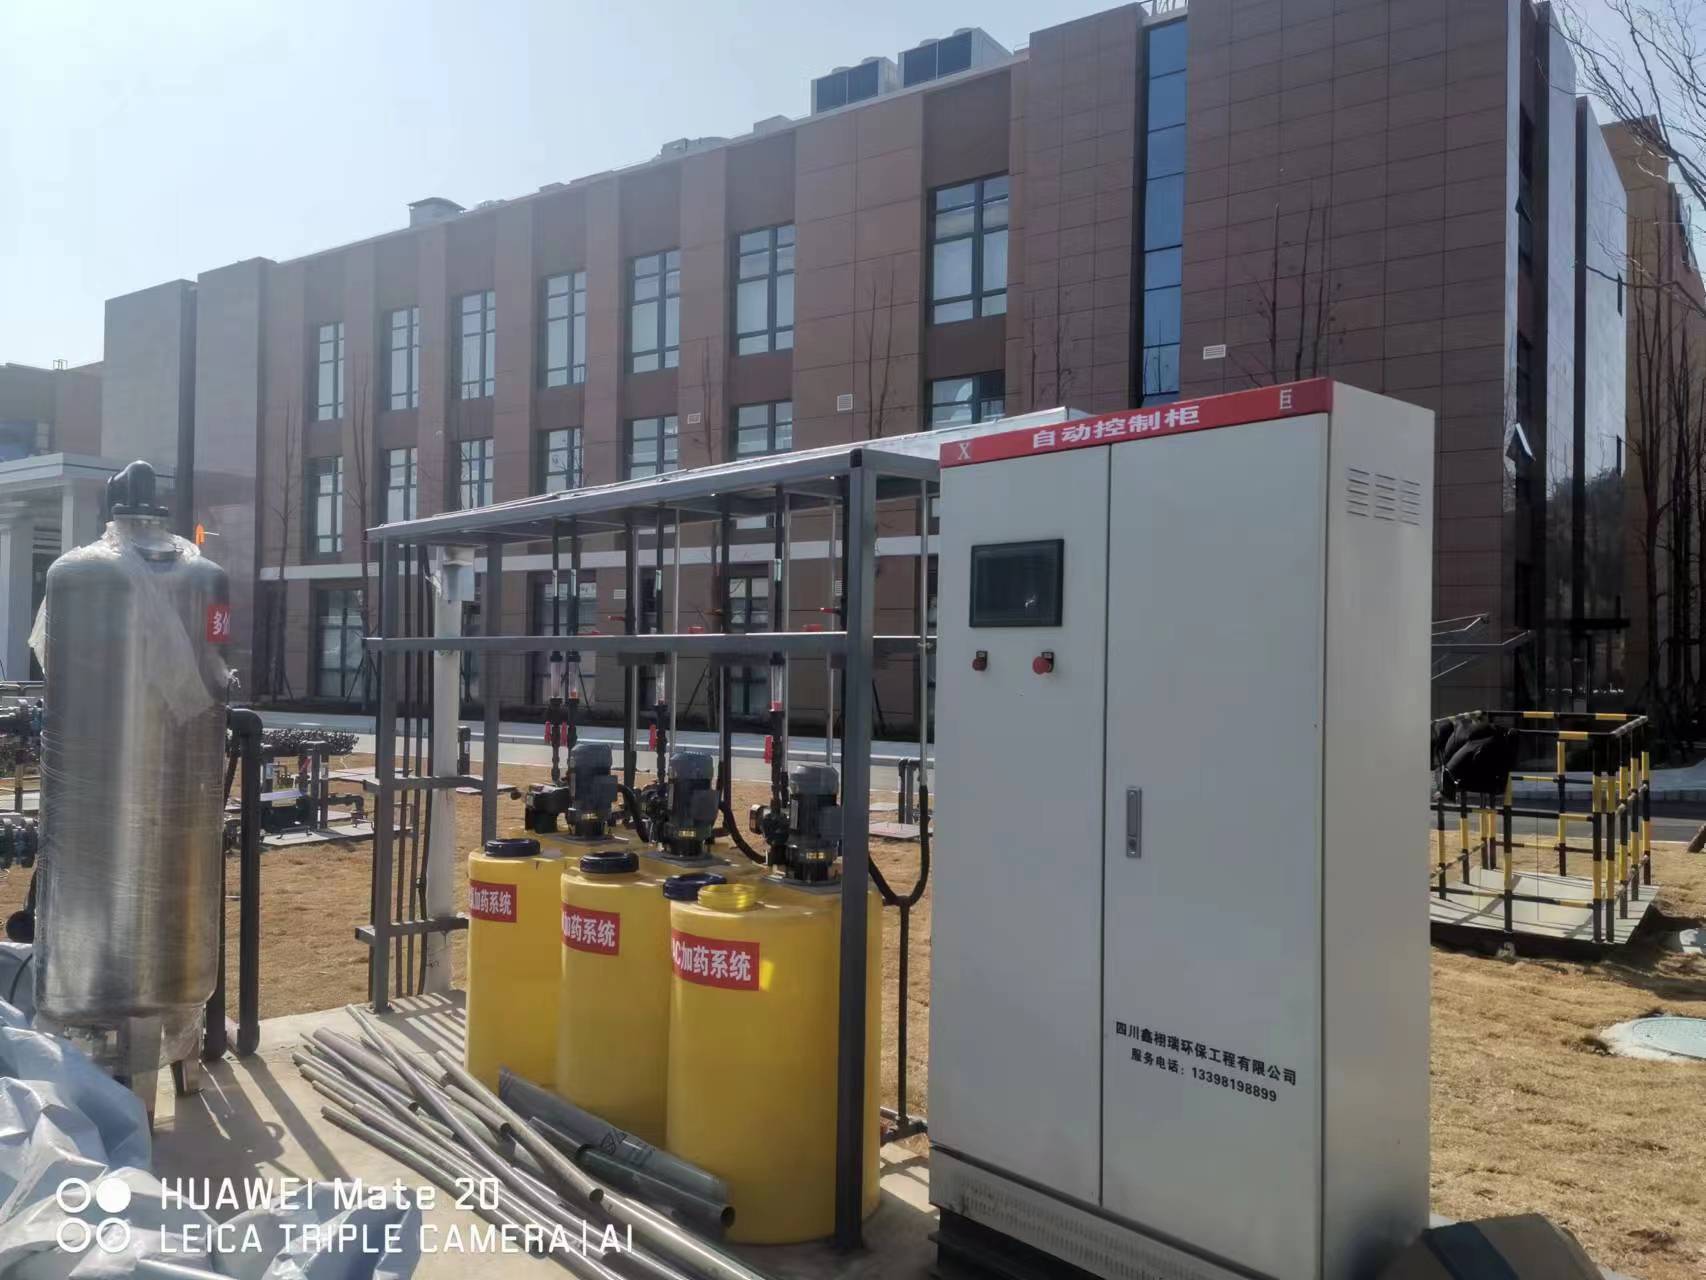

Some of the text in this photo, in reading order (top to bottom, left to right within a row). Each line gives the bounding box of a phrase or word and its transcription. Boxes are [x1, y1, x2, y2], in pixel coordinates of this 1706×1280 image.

[1033, 405, 1200, 448] 自动控制柜
[1116, 1020, 1296, 1086] 四川鑫栩瑞环保工程有限公司
